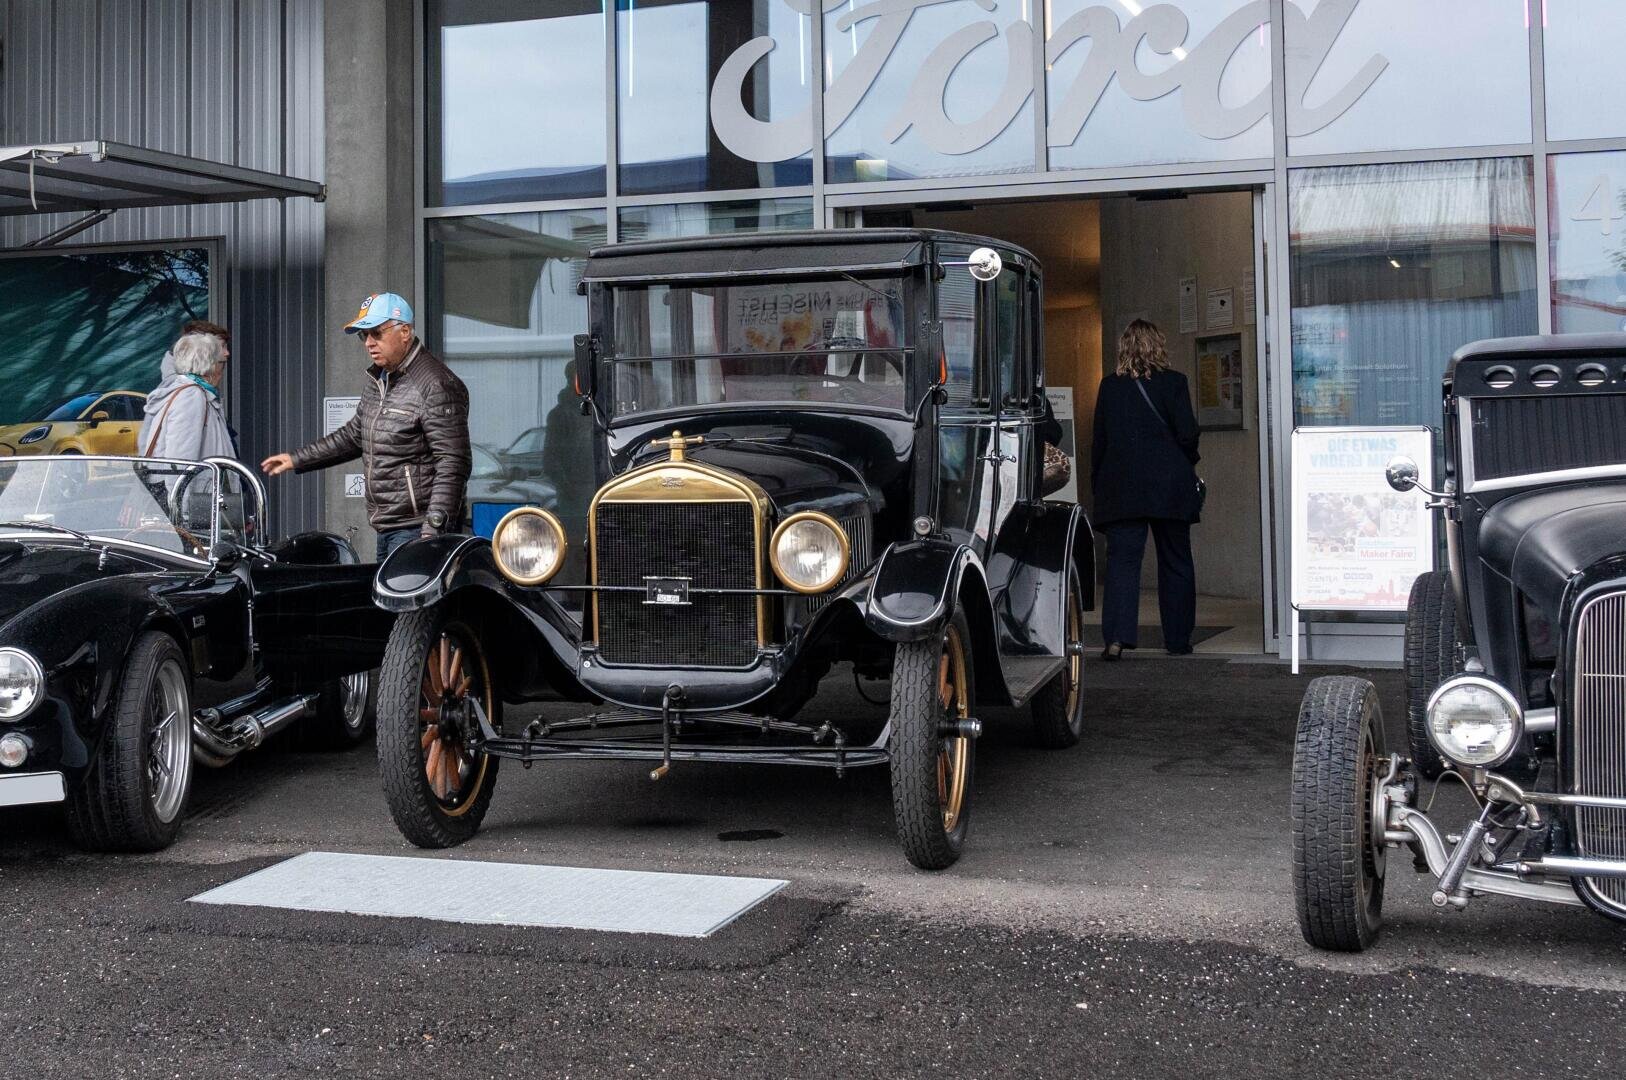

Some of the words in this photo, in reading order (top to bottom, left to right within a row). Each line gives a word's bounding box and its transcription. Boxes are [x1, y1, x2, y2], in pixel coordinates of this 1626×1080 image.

[710, 0, 1389, 163] Ford
[1360, 549, 1388, 559] Maker
[1391, 549, 1413, 559] Faire
